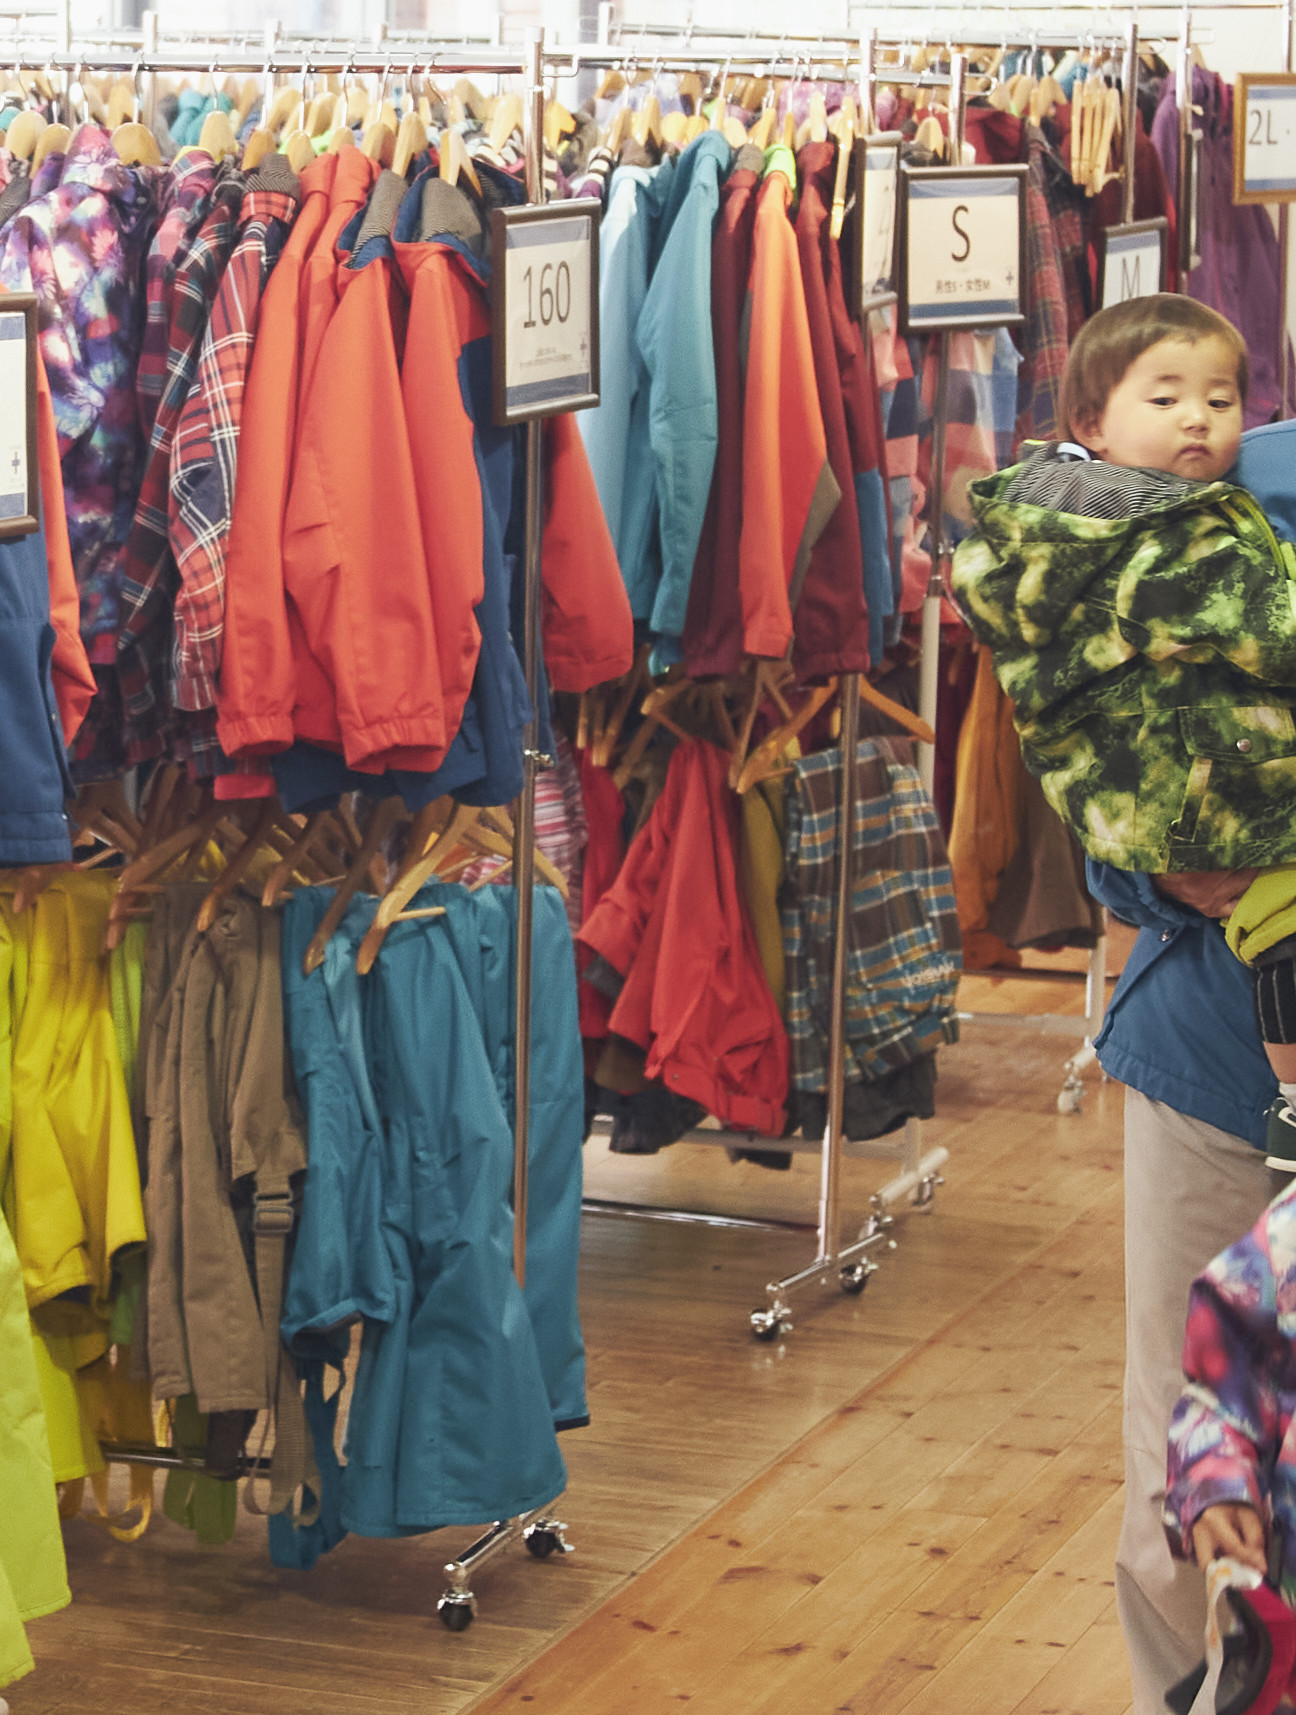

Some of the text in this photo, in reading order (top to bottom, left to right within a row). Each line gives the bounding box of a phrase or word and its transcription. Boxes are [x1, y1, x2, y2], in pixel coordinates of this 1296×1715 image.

[951, 205, 971, 262] S
[523, 260, 571, 328] 160
[1121, 255, 1140, 301] M
